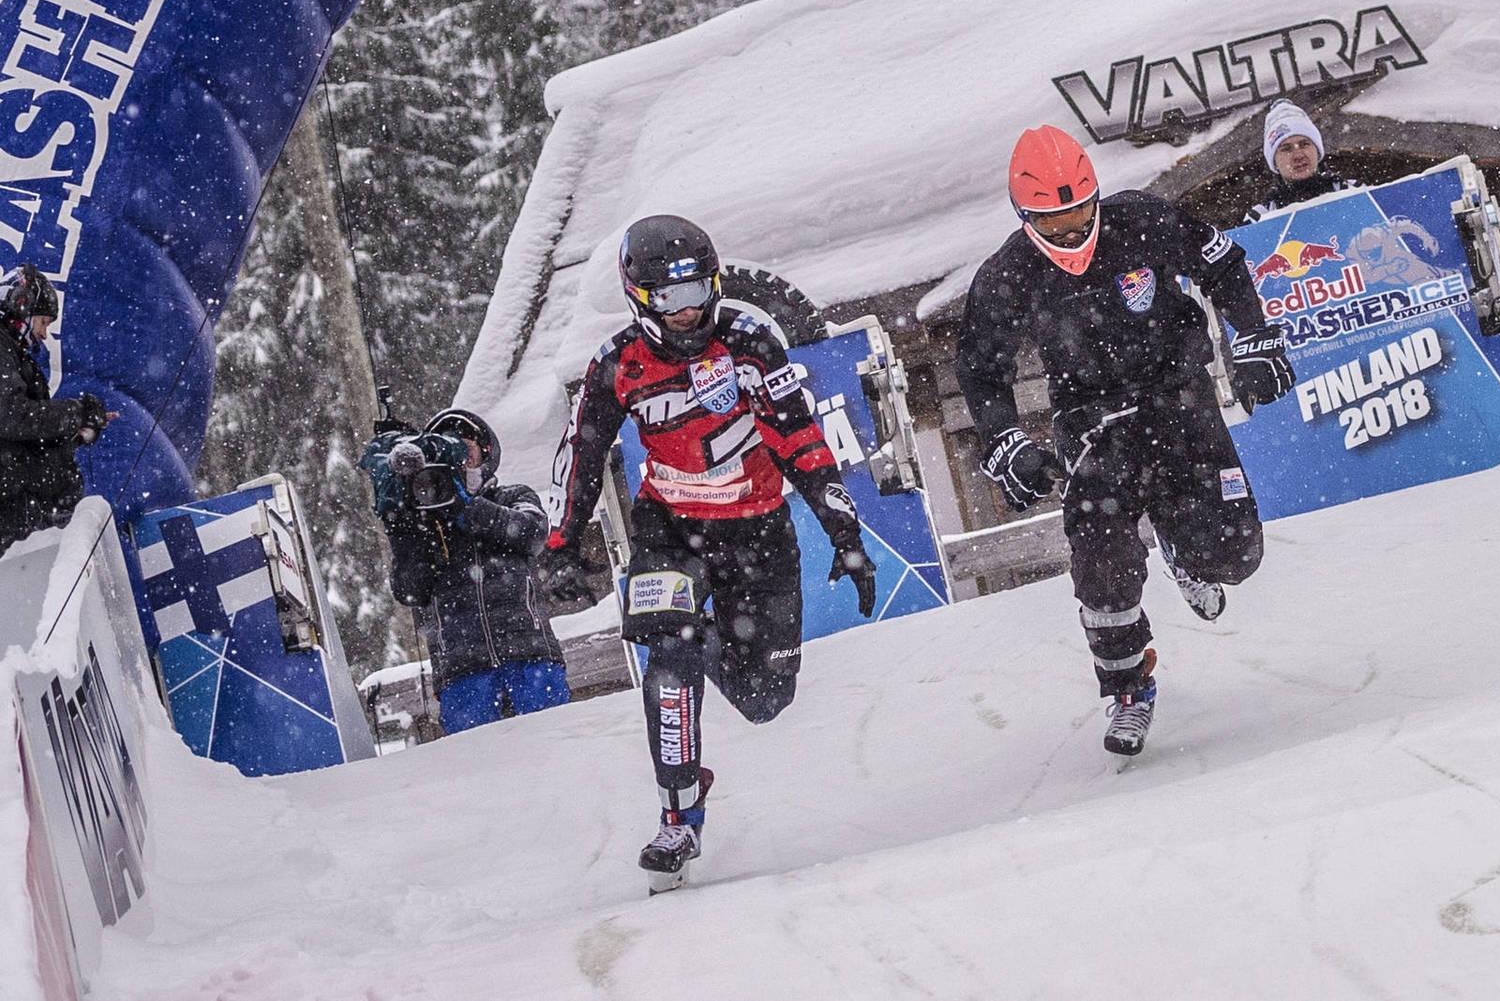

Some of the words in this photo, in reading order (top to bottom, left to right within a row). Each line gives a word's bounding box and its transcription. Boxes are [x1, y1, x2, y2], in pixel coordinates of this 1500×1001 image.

[1052, 5, 1427, 144] VALTRA
[1258, 279, 1306, 320] ed
[1303, 264, 1367, 307] Bull
[1408, 274, 1466, 303] ICE
[1346, 331, 1377, 345] WORLD
[694, 372, 716, 389] Red
[713, 362, 733, 378] Bull
[1295, 327, 1443, 423] FINLAND
[711, 388, 736, 411] 830
[1338, 379, 1431, 450] 2018
[635, 579, 663, 589] Neste
[634, 596, 660, 608] lampi
[659, 725, 683, 766] GREAT
